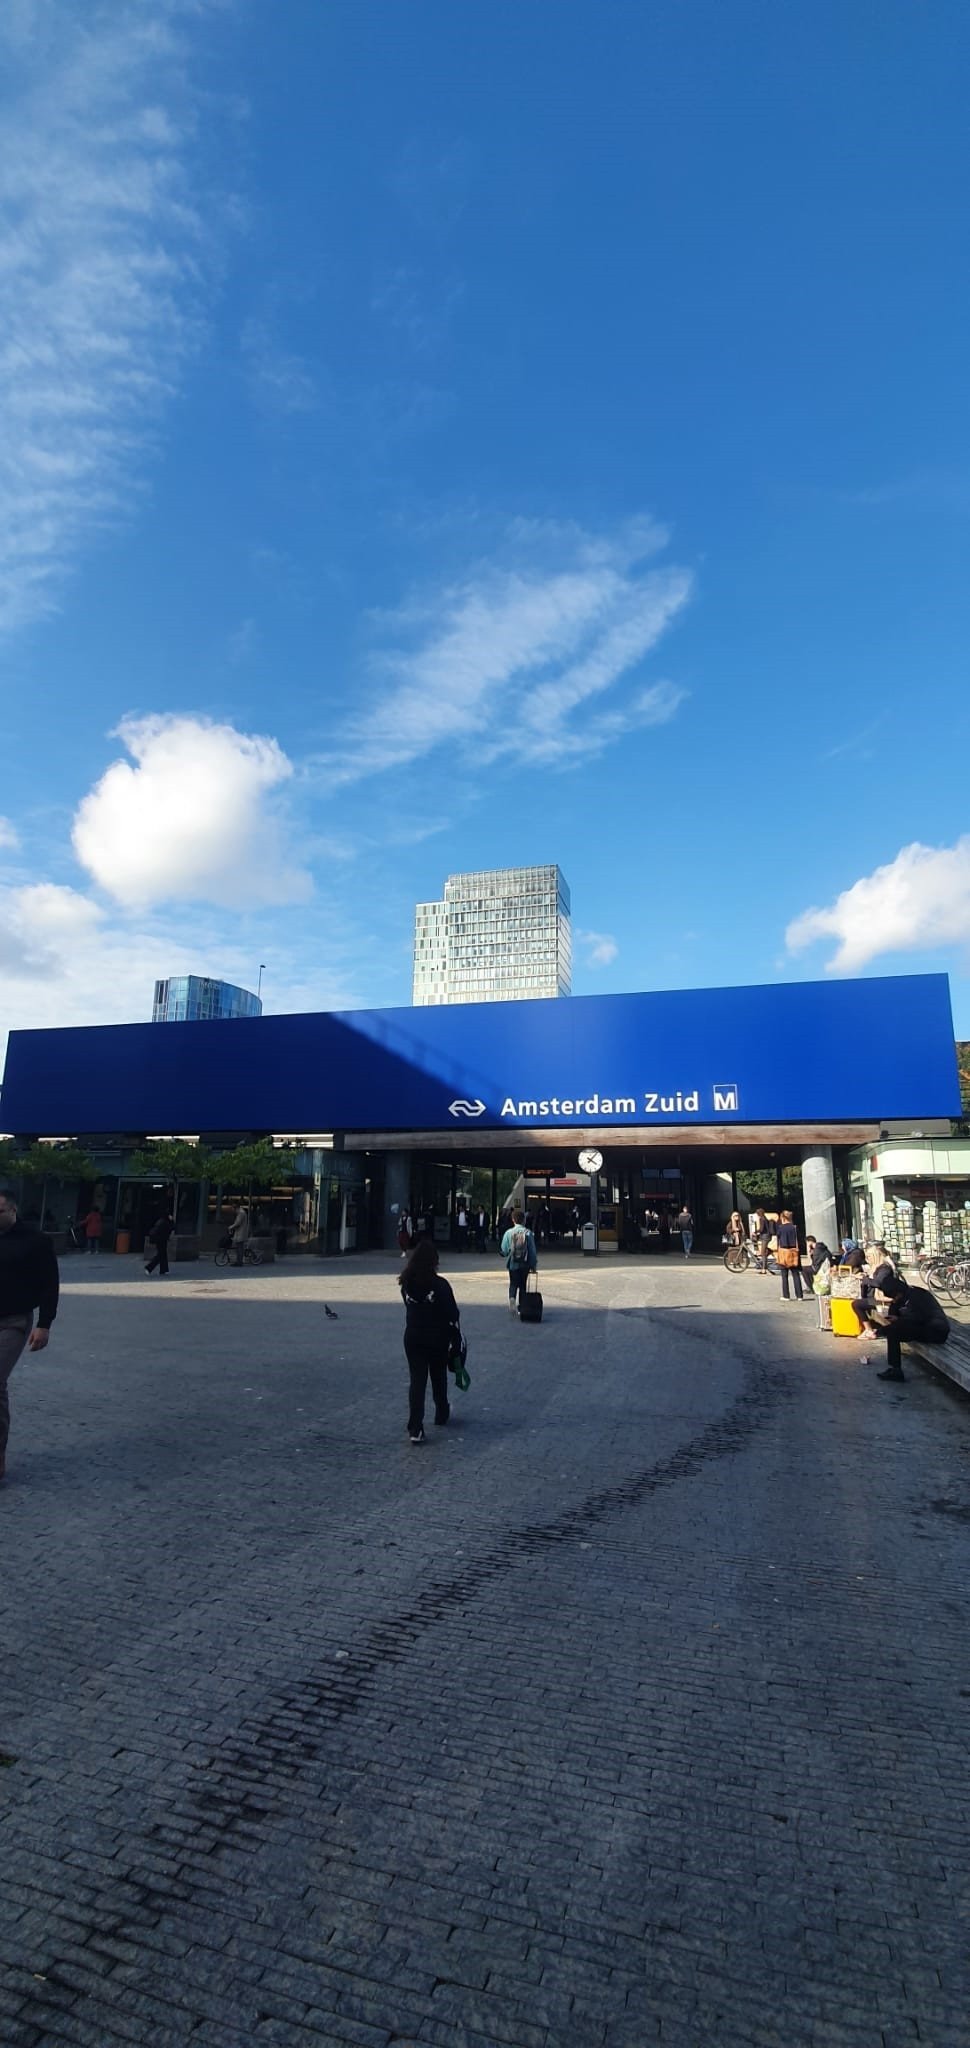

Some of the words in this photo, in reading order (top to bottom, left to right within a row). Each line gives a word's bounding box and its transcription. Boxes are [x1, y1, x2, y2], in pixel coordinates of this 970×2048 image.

[501, 1094, 636, 1116] Amsterdam
[645, 1091, 699, 1112] Zuid
[714, 1091, 736, 1110] M
